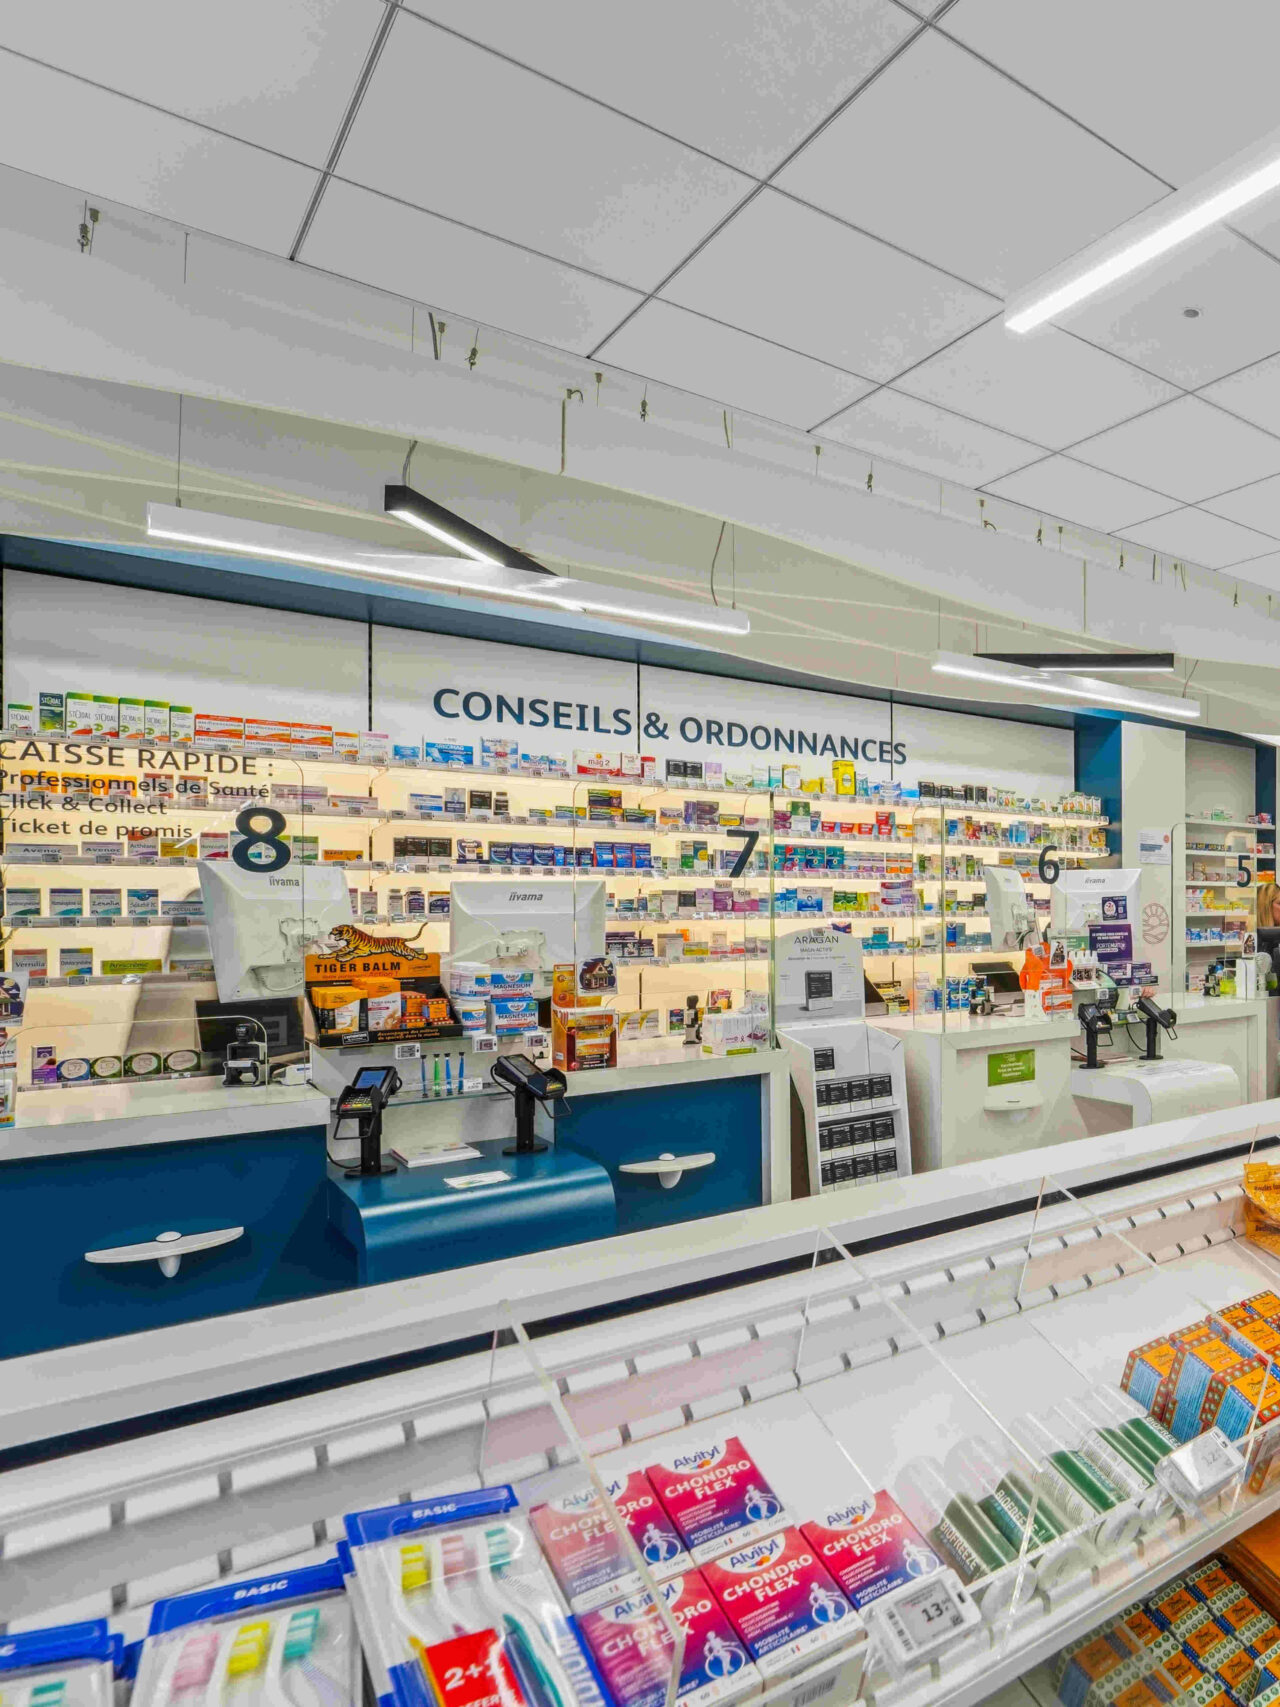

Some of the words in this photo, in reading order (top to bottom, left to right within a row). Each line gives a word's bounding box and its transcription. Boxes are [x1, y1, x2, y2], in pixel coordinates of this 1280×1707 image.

[433, 688, 632, 736] CONSEILS
[643, 711, 669, 740] &
[680, 716, 907, 765] ORDONNANCES
[0, 738, 125, 767] CAISSE
[138, 749, 257, 775] RAPIDE
[0, 769, 168, 793] Professionnels
[176, 780, 201, 794] de
[209, 781, 270, 798] Santé
[0, 793, 53, 811] Click
[61, 796, 81, 811] &
[88, 797, 168, 815] Collect
[0, 817, 71, 835] Ticket
[79, 820, 108, 836] de
[116, 824, 192, 840] promis
[232, 807, 291, 873] 8
[726, 829, 760, 878] 7
[1039, 845, 1060, 884] 6
[1237, 855, 1251, 888] 5
[794, 935, 839, 945] ARAGAN
[314, 963, 357, 974] TIGER
[363, 961, 401, 972] BALM
[673, 1445, 721, 1469] Alvityl
[664, 1460, 752, 1498] CHONDRO
[694, 1476, 737, 1499] FLEX
[412, 1502, 457, 1519] BASIC
[826, 1499, 871, 1526] Alvityl
[822, 1513, 902, 1556] CHONDRO
[853, 1530, 892, 1557] FLEX
[940, 1519, 977, 1569] BIOFREEZE
[729, 1539, 780, 1569] Alvityl
[233, 1579, 289, 1600] BASIC
[722, 1554, 813, 1602] CHONDRO
[754, 1574, 799, 1602] FLEX
[922, 1602, 944, 1623] 13
